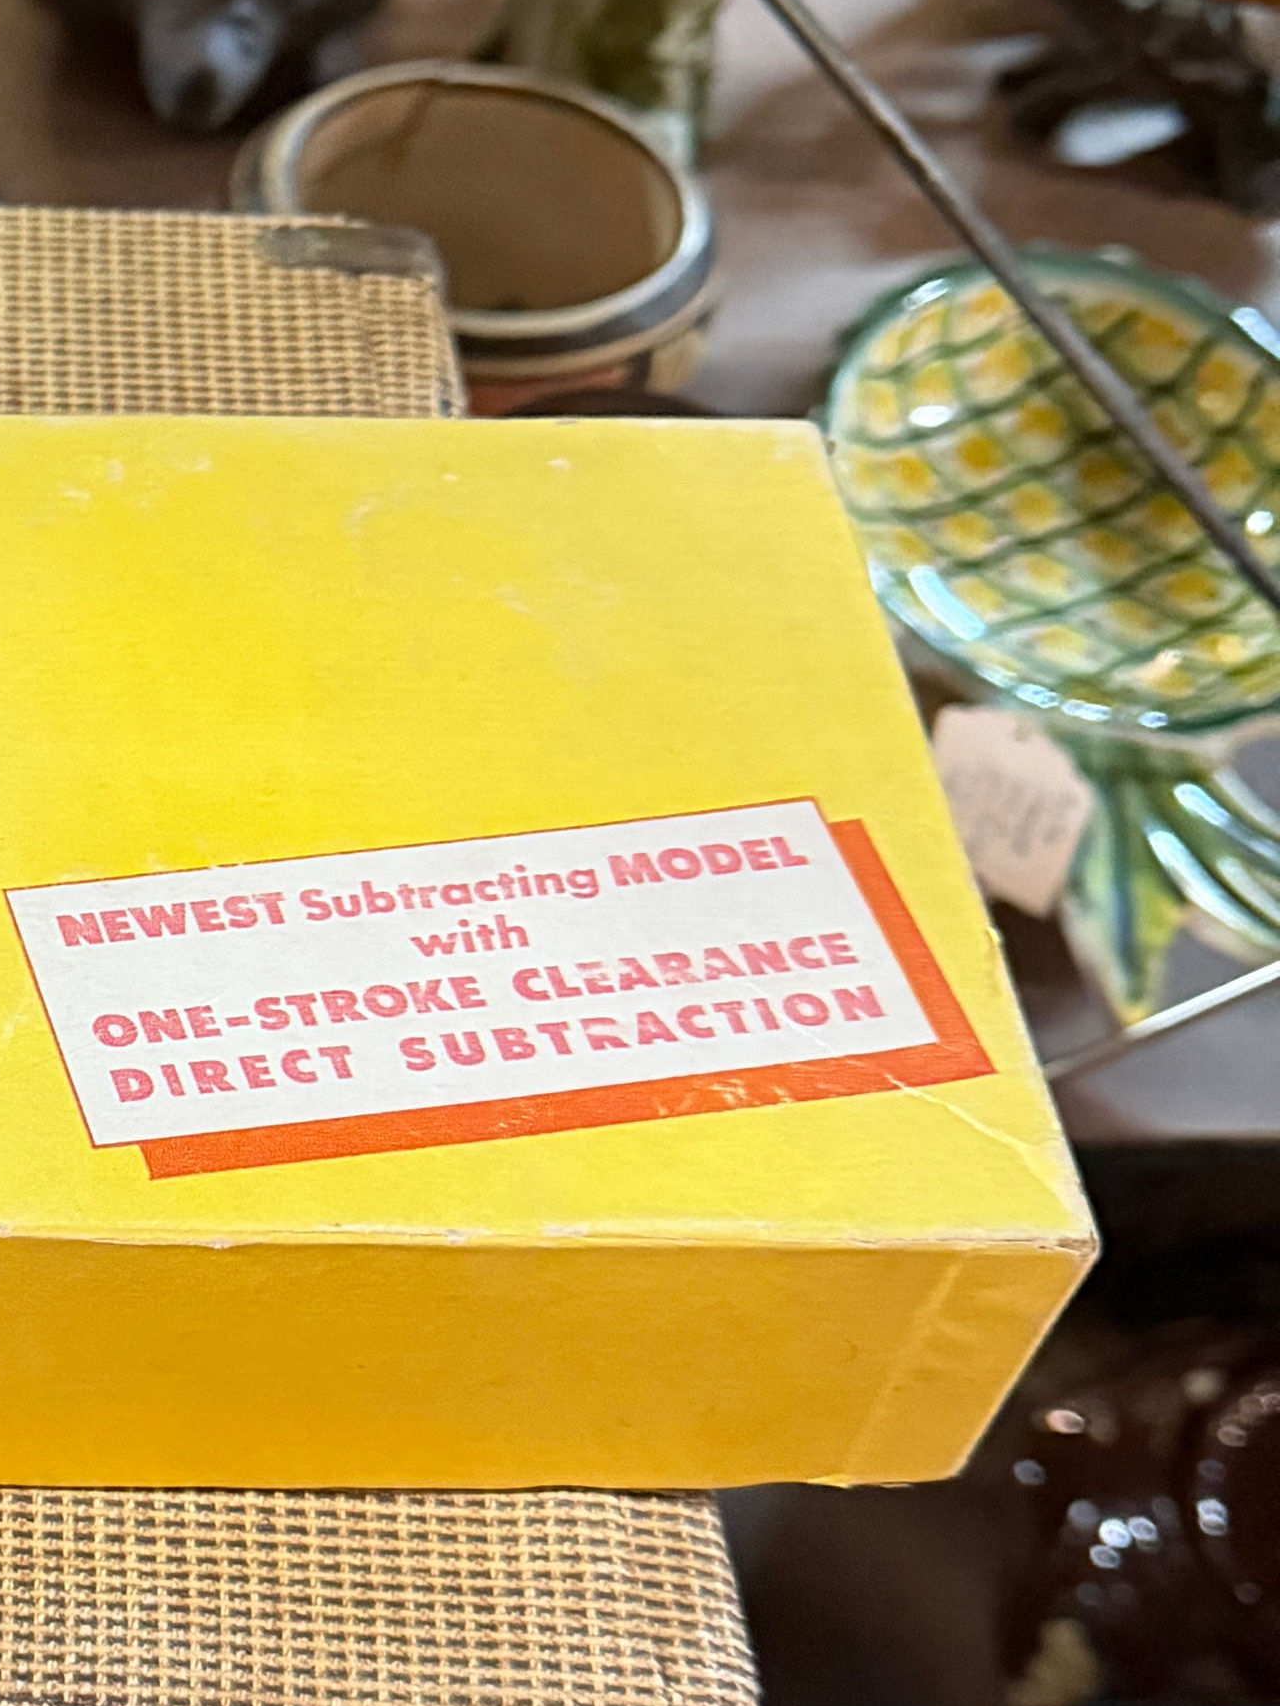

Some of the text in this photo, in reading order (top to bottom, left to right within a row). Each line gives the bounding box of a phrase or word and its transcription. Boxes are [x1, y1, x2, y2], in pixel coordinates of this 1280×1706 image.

[56, 836, 810, 948] NEWEST Subtracting MODEL
[410, 914, 530, 958] with
[91, 932, 860, 1048] ONE-STROKE CLEARANCE
[109, 985, 886, 1103] DIRECT SUBTRACTION
